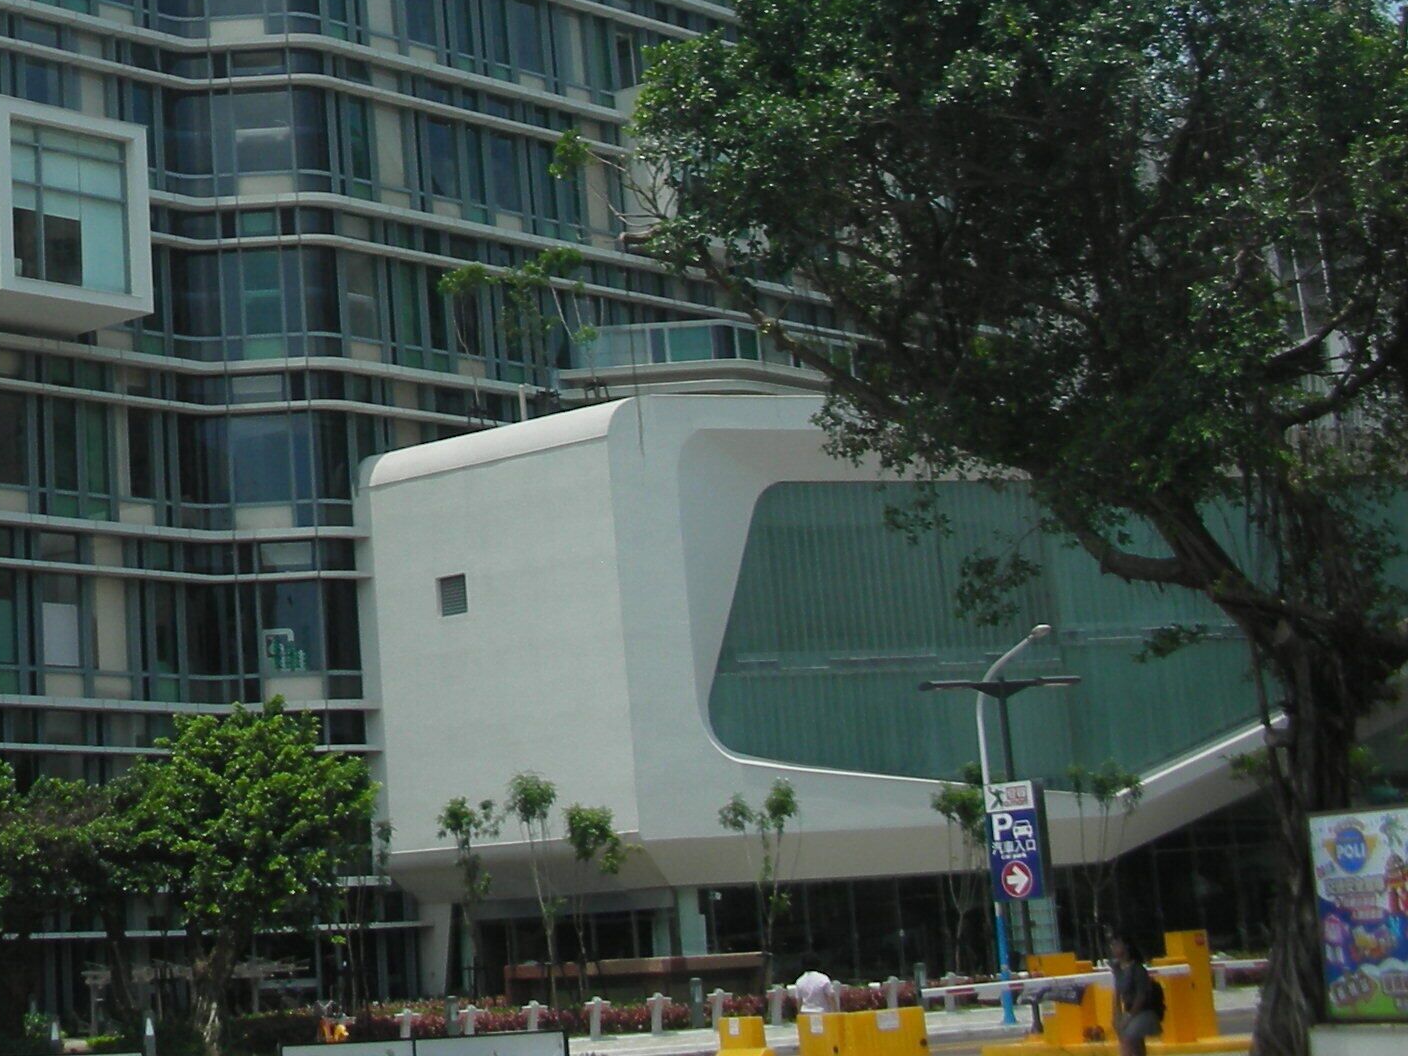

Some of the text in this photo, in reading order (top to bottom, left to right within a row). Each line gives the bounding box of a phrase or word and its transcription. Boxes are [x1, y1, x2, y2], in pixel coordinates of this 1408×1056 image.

[992, 812, 1013, 841] P
[991, 839, 1037, 855] 汽車入口
